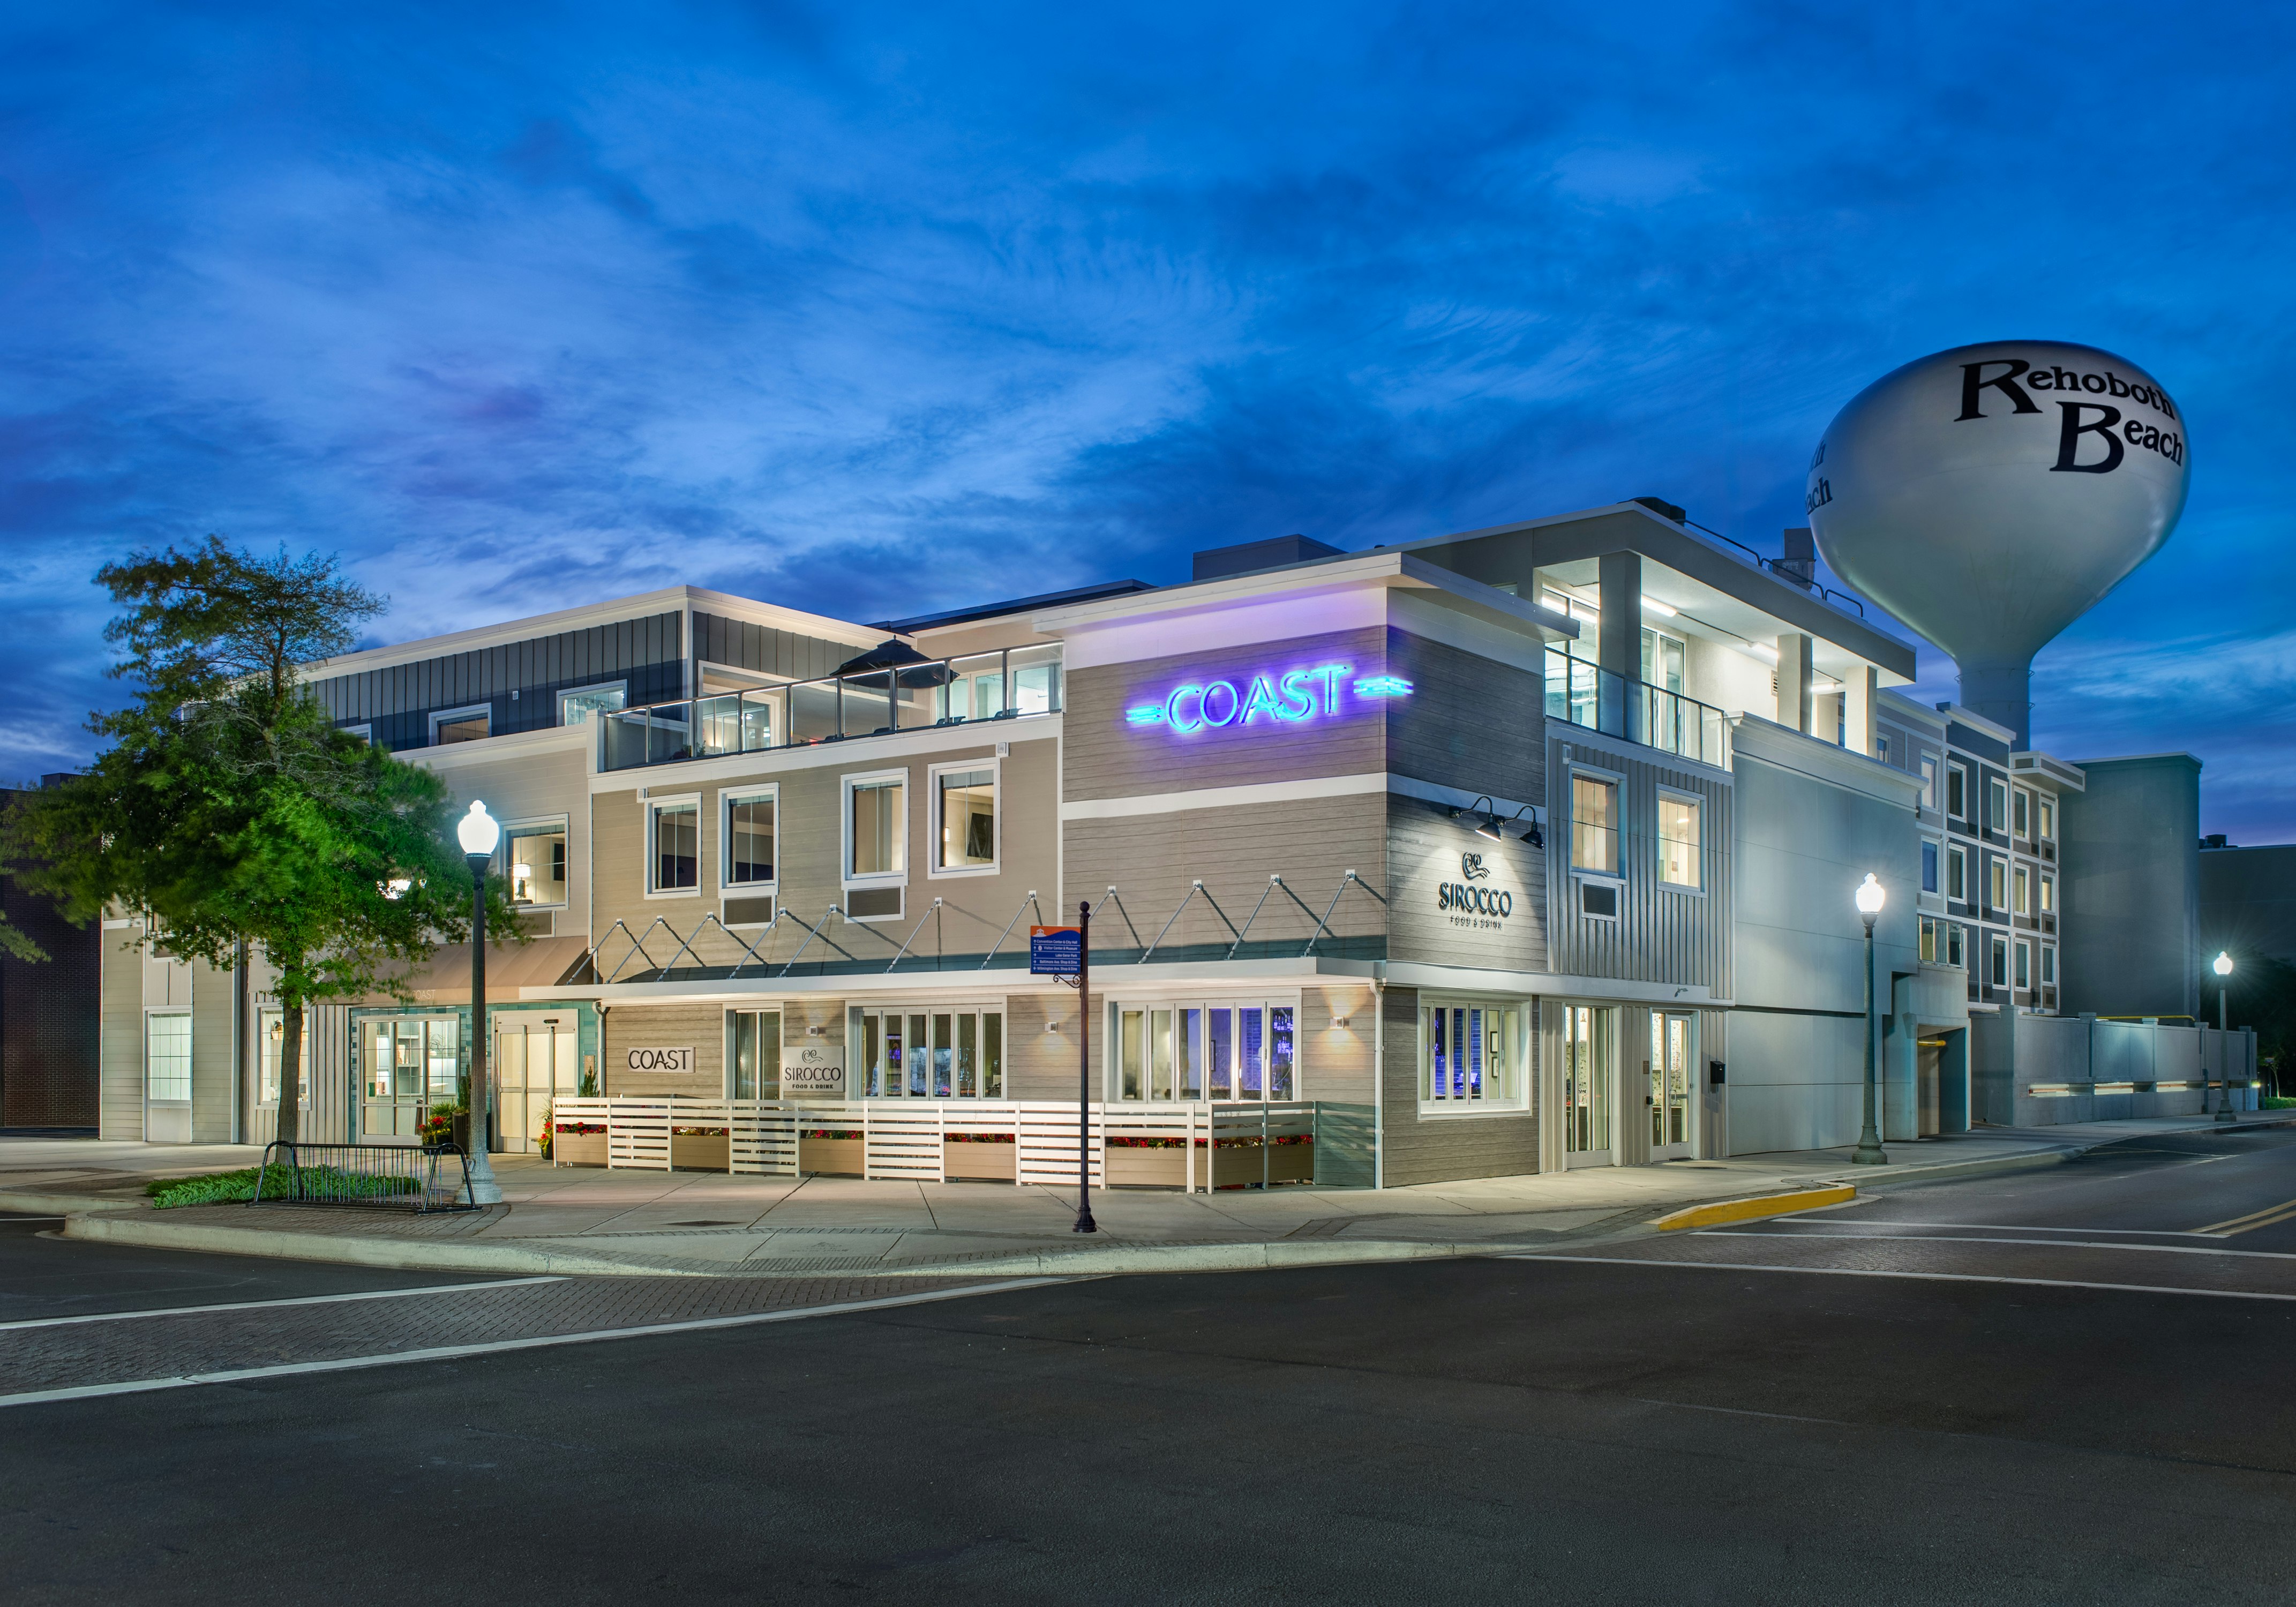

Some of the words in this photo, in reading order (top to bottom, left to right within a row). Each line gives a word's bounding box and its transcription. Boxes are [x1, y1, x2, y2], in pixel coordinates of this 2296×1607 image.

[1954, 359, 2175, 422] Rehoboth
[2049, 401, 2183, 474] Beach
[1805, 476, 1833, 515] ach
[1165, 664, 1352, 734] COAST
[1439, 882, 1512, 915] SIROCCO
[1451, 915, 1471, 927] FOOD
[1474, 918, 1477, 928] &
[1480, 919, 1503, 930] DRINK
[628, 1050, 691, 1070] COAST
[785, 1067, 841, 1081] SIROCCO
